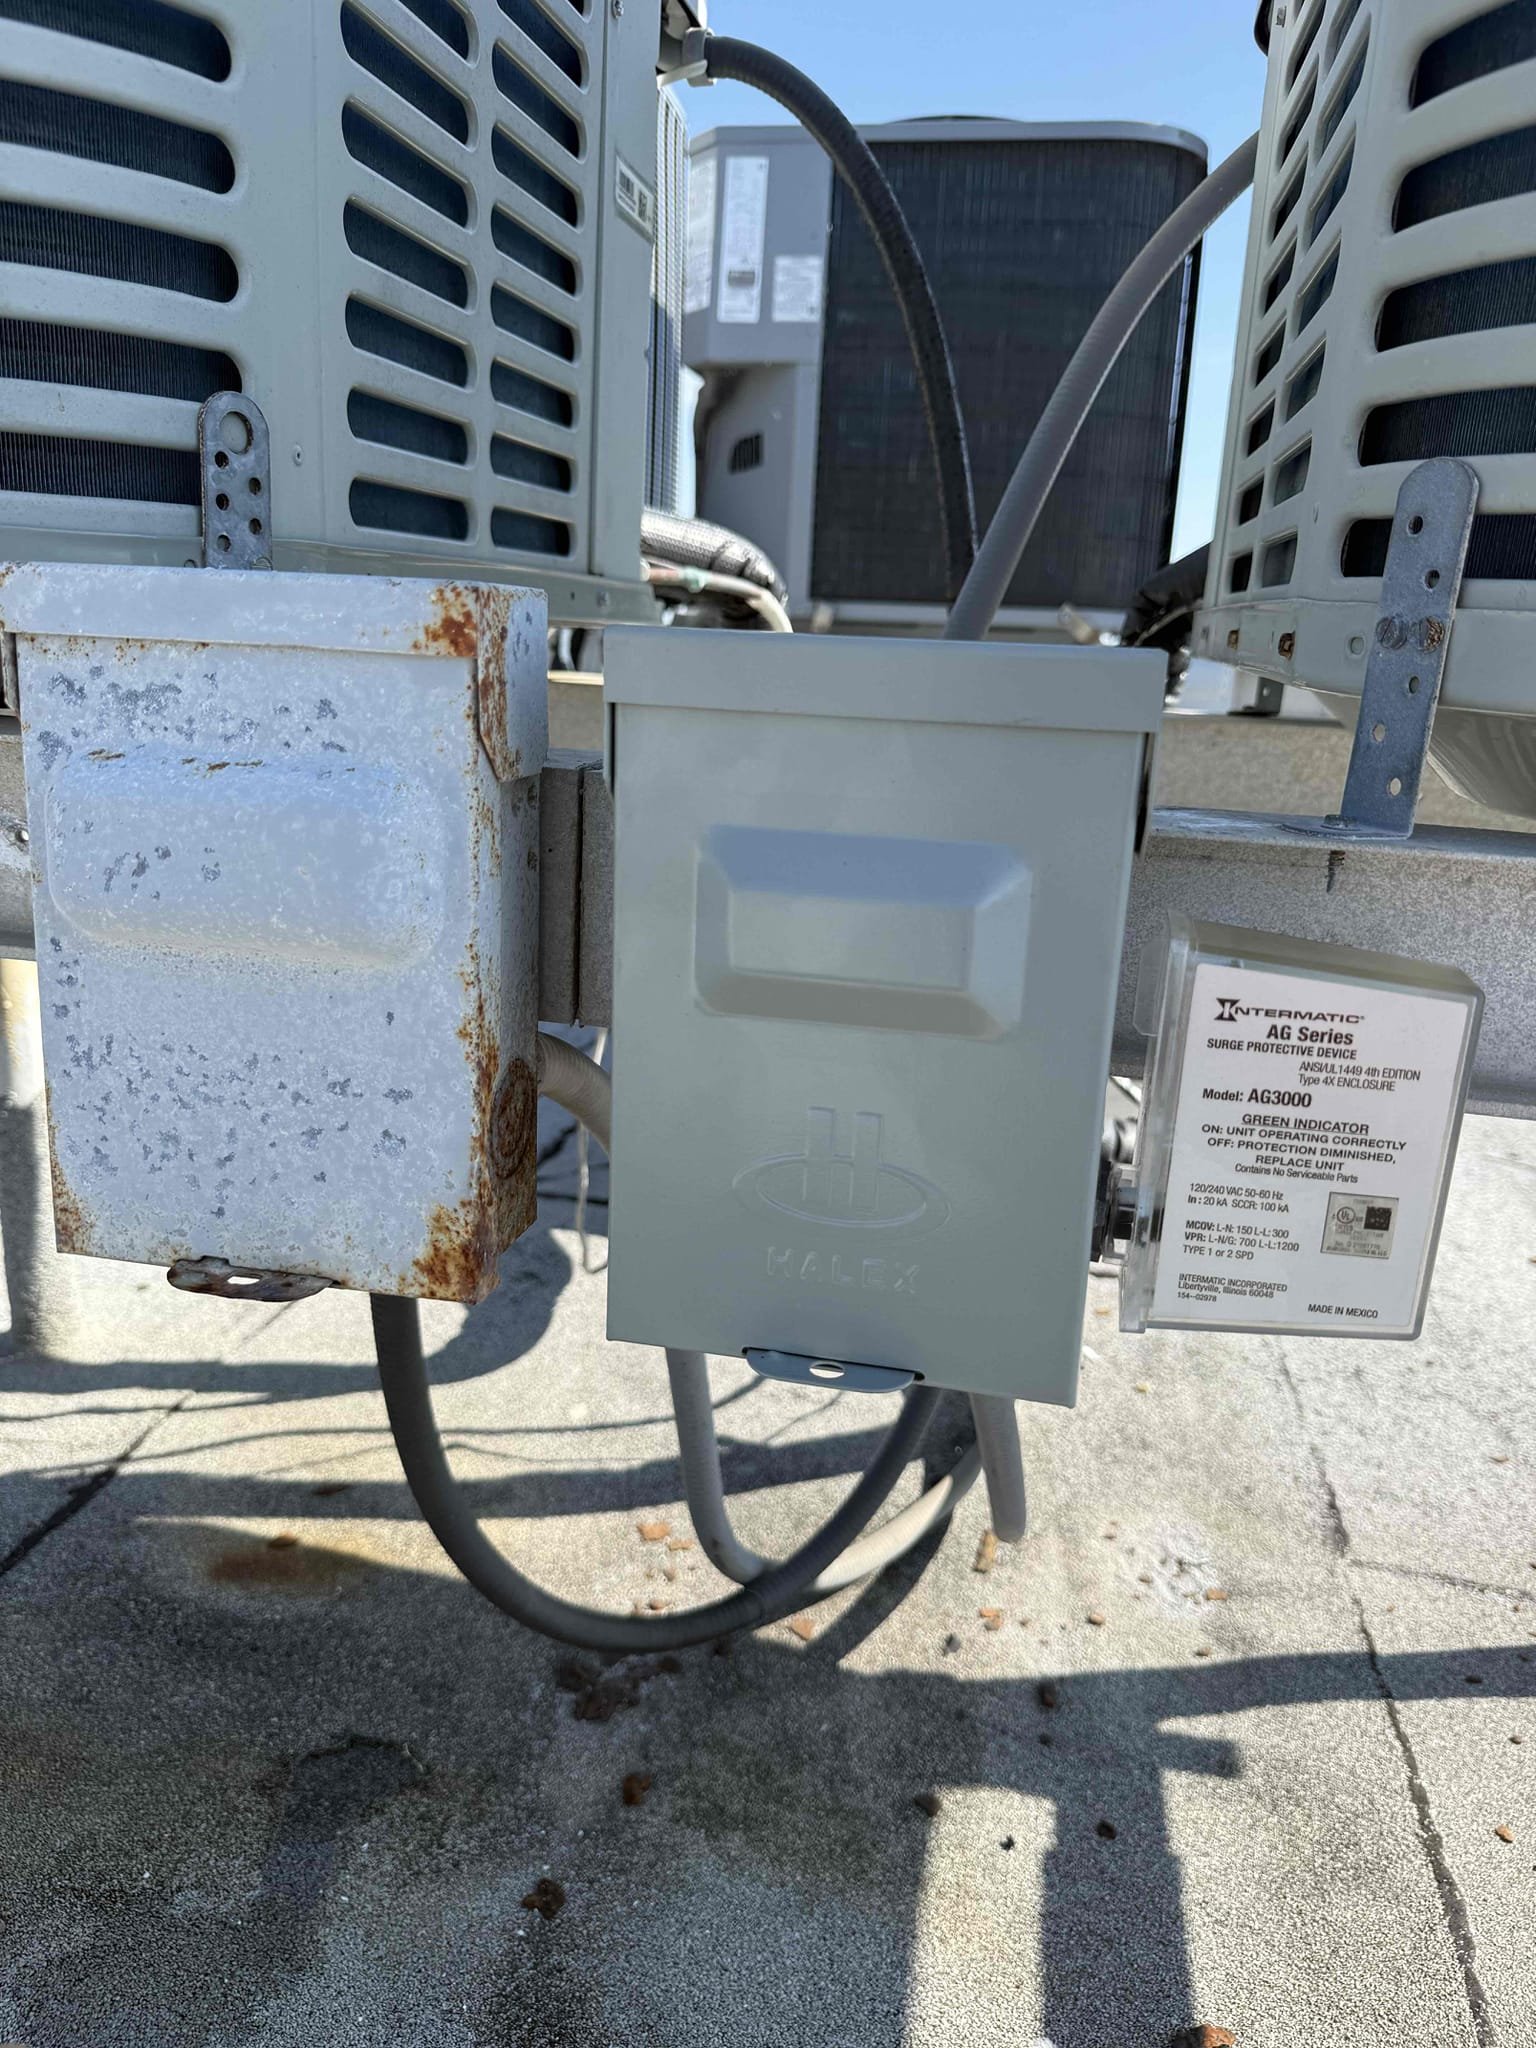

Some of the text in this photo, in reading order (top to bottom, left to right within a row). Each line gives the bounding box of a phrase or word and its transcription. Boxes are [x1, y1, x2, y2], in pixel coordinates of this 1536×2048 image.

[1266, 1024, 1354, 1046] AG Series
[1206, 1038, 1357, 1060] SURGE PROTECTIVE DEVICE
[1298, 1073, 1396, 1092] Type 4X ENCLOSURE
[1364, 1067, 1380, 1078] 4th
[1382, 1068, 1421, 1081] EDITION
[1202, 1087, 1312, 1109] Model: AG3000
[1242, 1113, 1370, 1135] GREEN INDICATOR
[1201, 1123, 1407, 1151] ON: UNIT OPERATING CORRECTLY
[1207, 1137, 1396, 1165] OFF: PROTECTION DIMINISHED,
[1255, 1154, 1345, 1171] REPLACE UNIT
[1235, 1163, 1358, 1184] Contains No Serviceable Parts
[1190, 1183, 1284, 1201] 120/240 VAC 50-60 Hz
[1203, 1196, 1215, 1206] 20
[1216, 1198, 1228, 1207] kA
[1231, 1199, 1258, 1210] SCCR:
[1260, 1202, 1276, 1212] 100
[1277, 1203, 1289, 1213] kA
[1185, 1220, 1215, 1231] MCOV:
[1216, 1223, 1234, 1234] L-N:
[1237, 1225, 1253, 1236] 150
[1184, 1232, 1206, 1243] VPR:
[1208, 1234, 1237, 1246] L-N/G:
[1239, 1237, 1257, 1248] 700
[1183, 1245, 1206, 1256] TYPE
[1215, 1249, 1225, 1257] or
[1226, 1249, 1233, 1258] 2
[1235, 1250, 1254, 1260] SPD
[767, 1246, 921, 1294] HALEX
[1178, 1273, 1288, 1292] INTERMATIC INCORPORATED
[1178, 1281, 1221, 1294] Libertyville,
[1222, 1286, 1247, 1296] Illinois
[1307, 1303, 1379, 1319] MADE IN MEXICO
